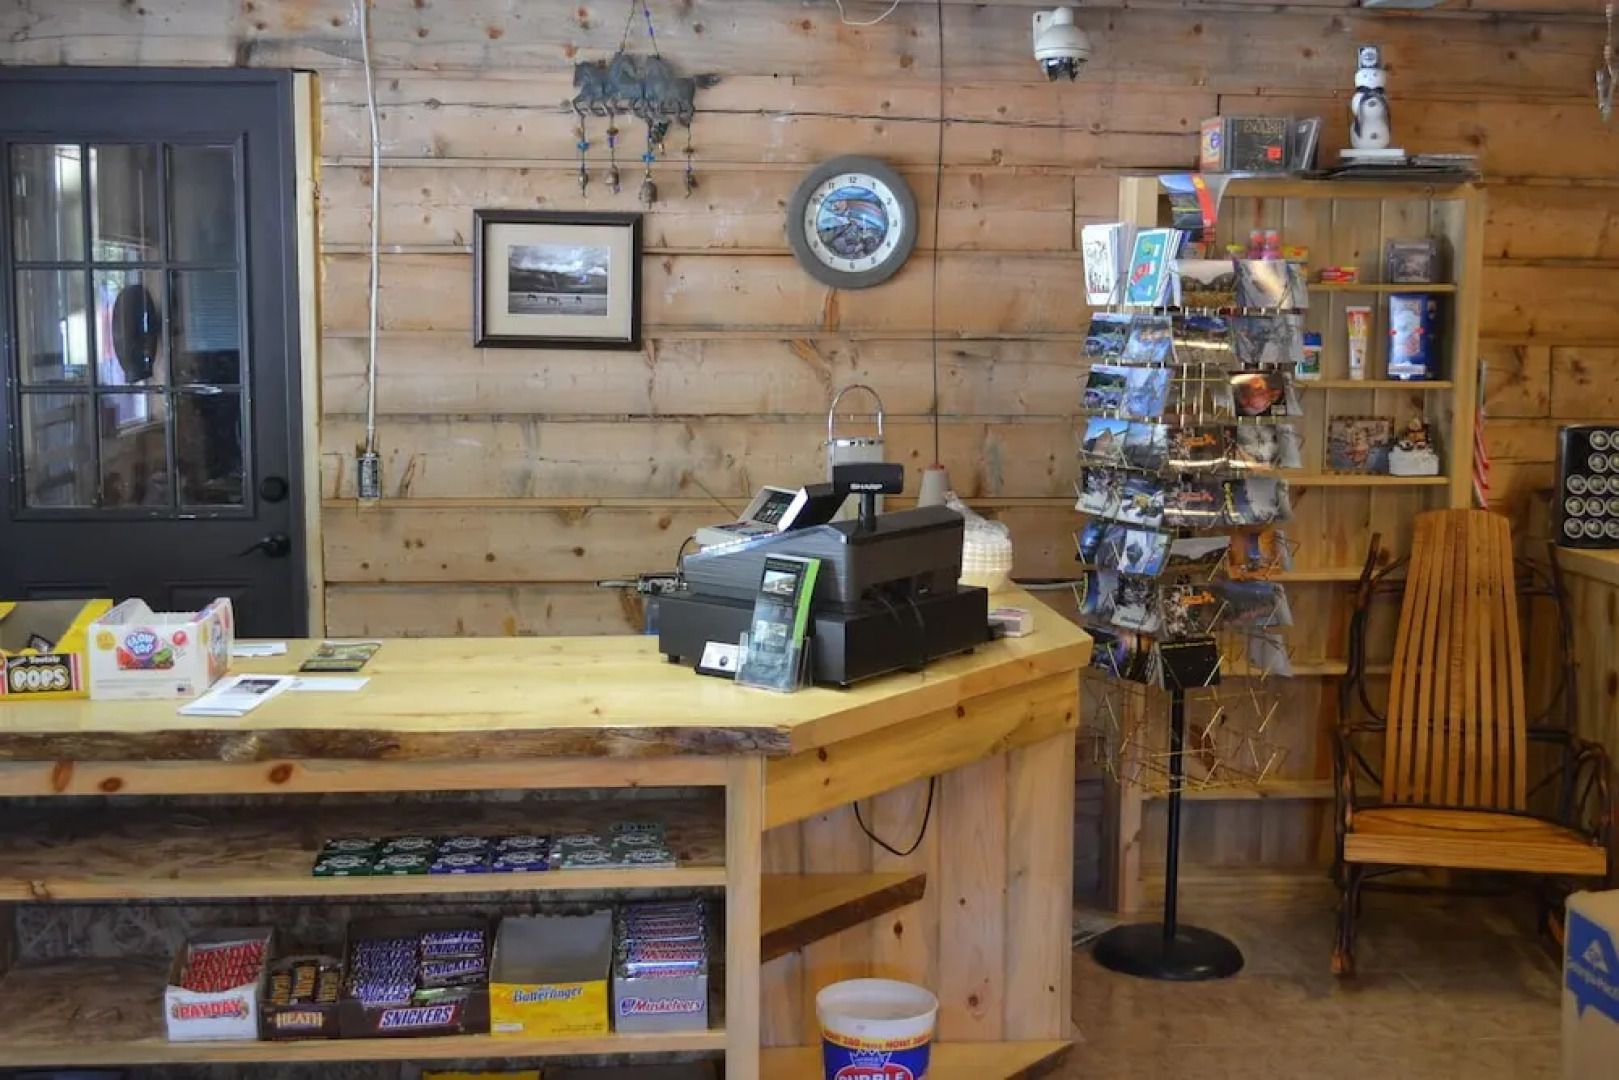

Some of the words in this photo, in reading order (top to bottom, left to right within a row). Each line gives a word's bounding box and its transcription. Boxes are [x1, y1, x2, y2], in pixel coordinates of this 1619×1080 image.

[12, 667, 68, 690] POPS
[513, 986, 584, 1004] Butterfinger
[177, 1000, 243, 1019] PAYDAY
[380, 1006, 453, 1027] SNICKERS
[276, 1011, 323, 1029] HEATH
